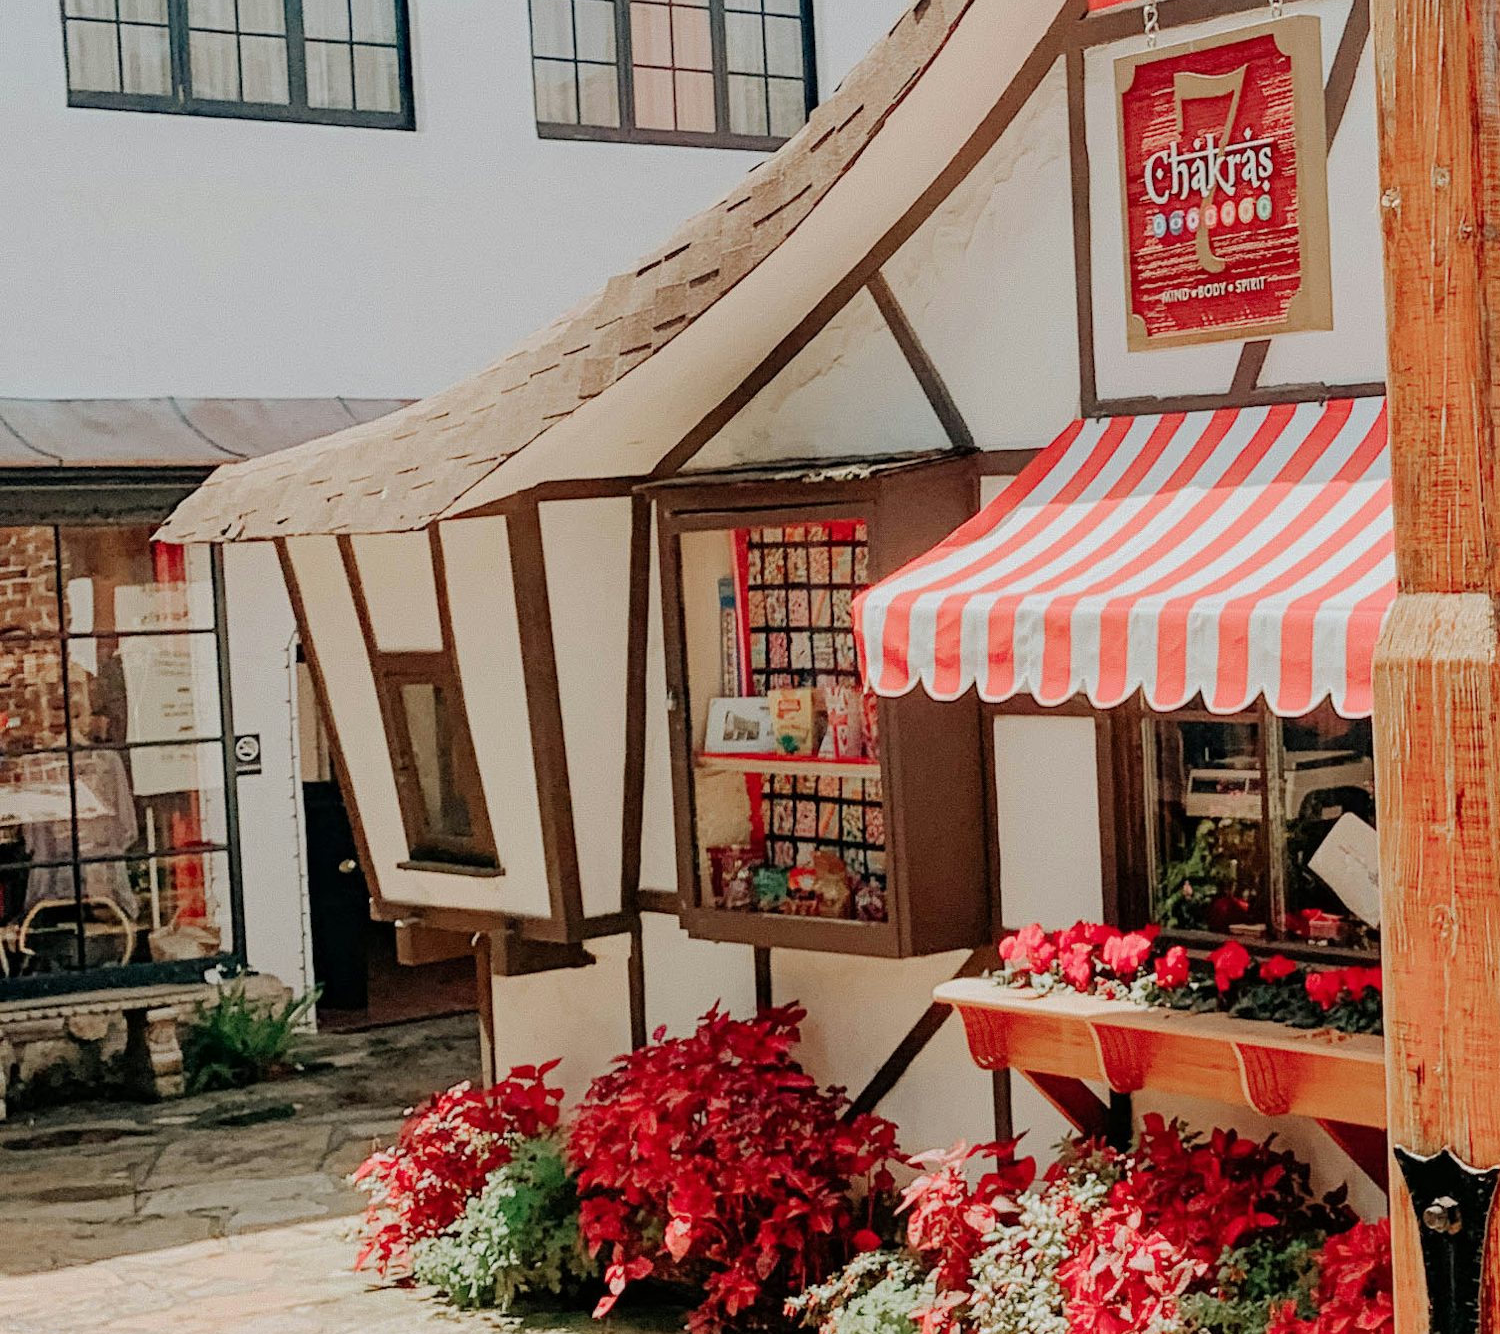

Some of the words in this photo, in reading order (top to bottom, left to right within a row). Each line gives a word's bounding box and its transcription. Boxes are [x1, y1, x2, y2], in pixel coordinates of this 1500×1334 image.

[1144, 126, 1275, 205] Chakras
[1173, 63, 1249, 274] 7
[1197, 281, 1227, 299] BODY
[1234, 275, 1267, 294] SPIRIT
